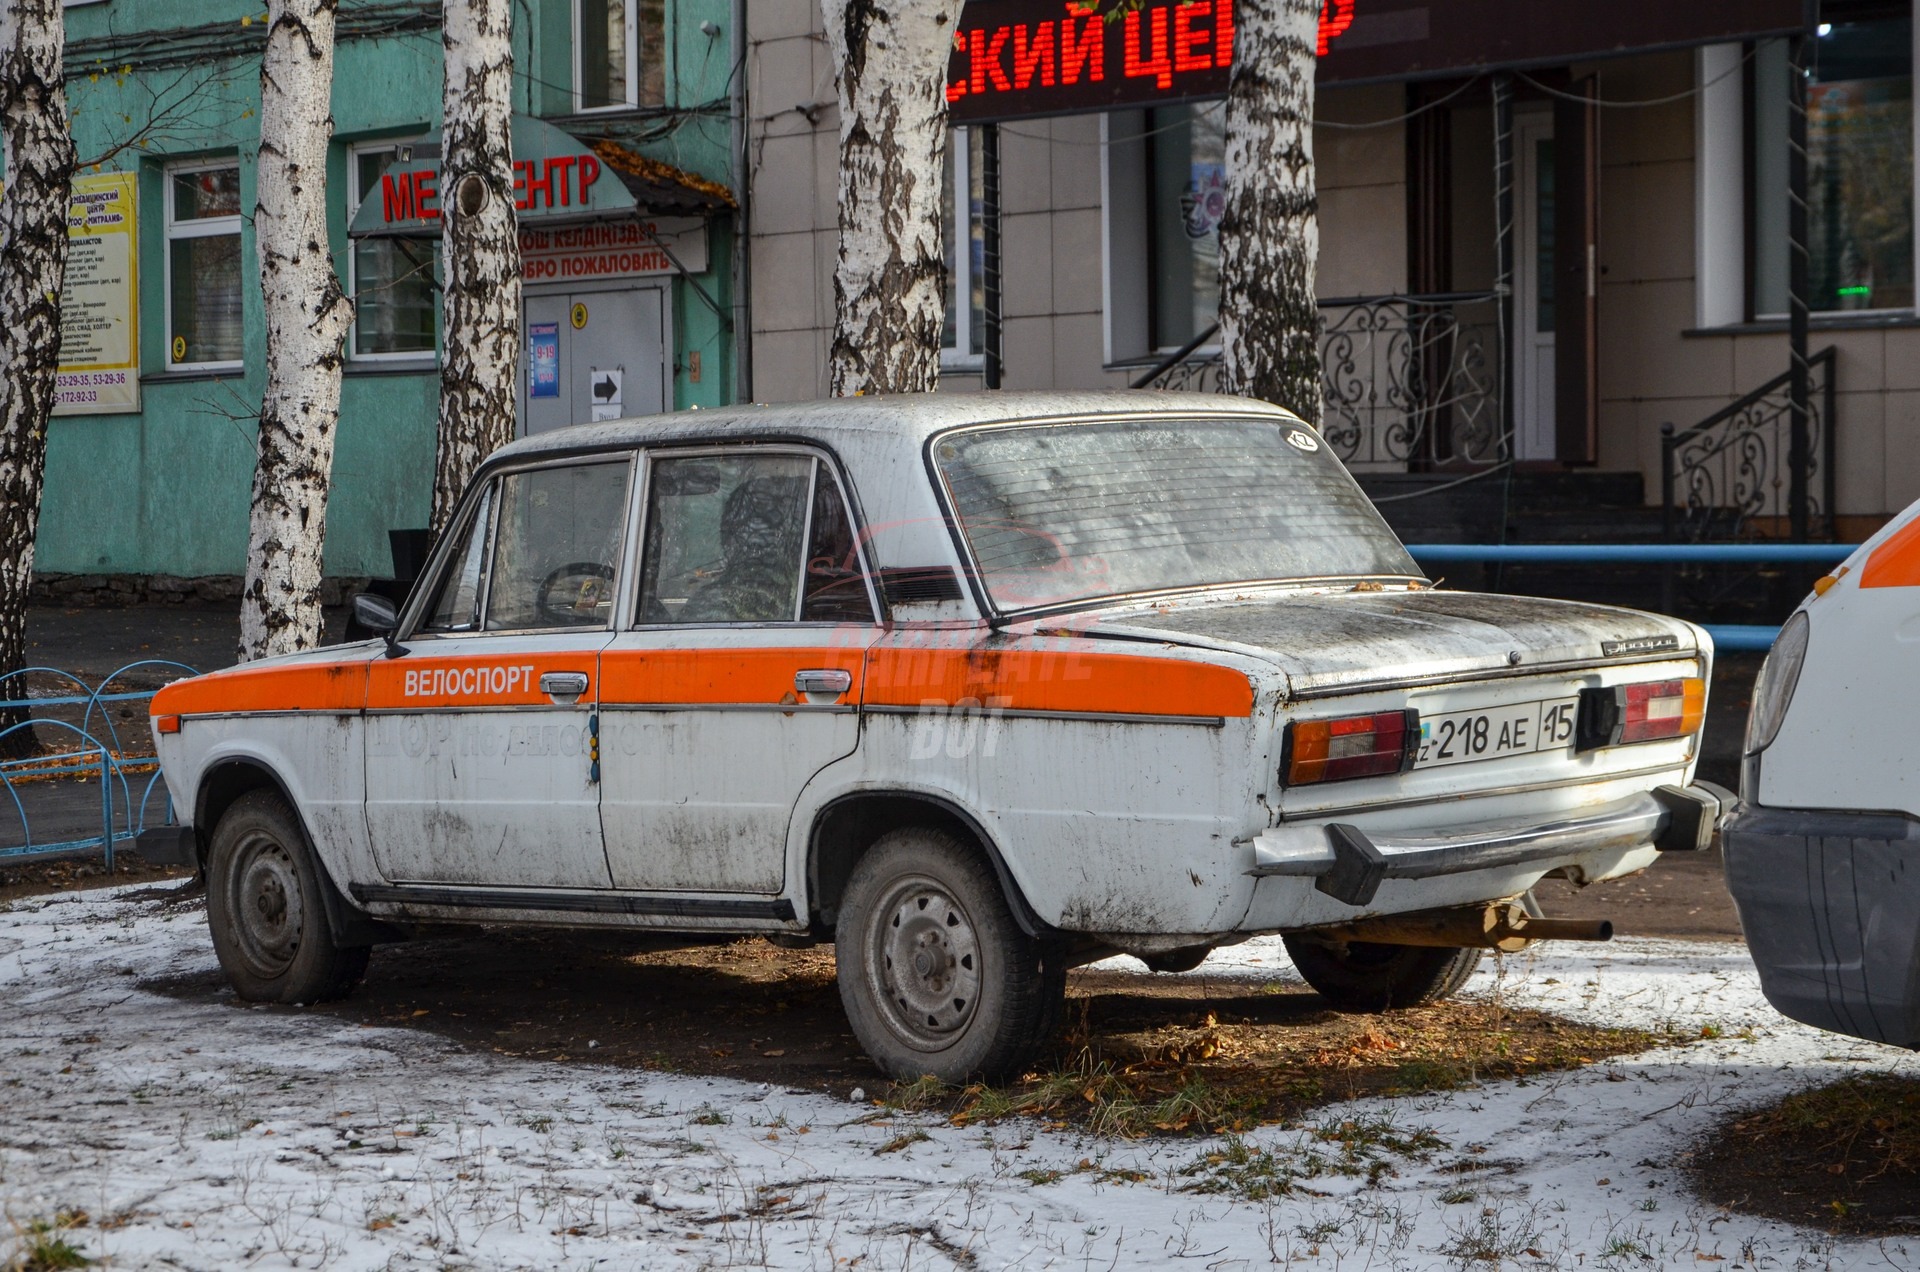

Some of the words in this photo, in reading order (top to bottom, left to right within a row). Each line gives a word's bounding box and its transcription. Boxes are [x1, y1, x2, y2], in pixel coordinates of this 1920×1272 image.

[561, 252, 669, 277] ПОЖАЛОВАТЬ
[404, 665, 534, 697] ВЕЛОСПОРТ
[1437, 714, 1490, 760] 218
[1497, 717, 1529, 751] AE
[1544, 703, 1574, 744] 15
